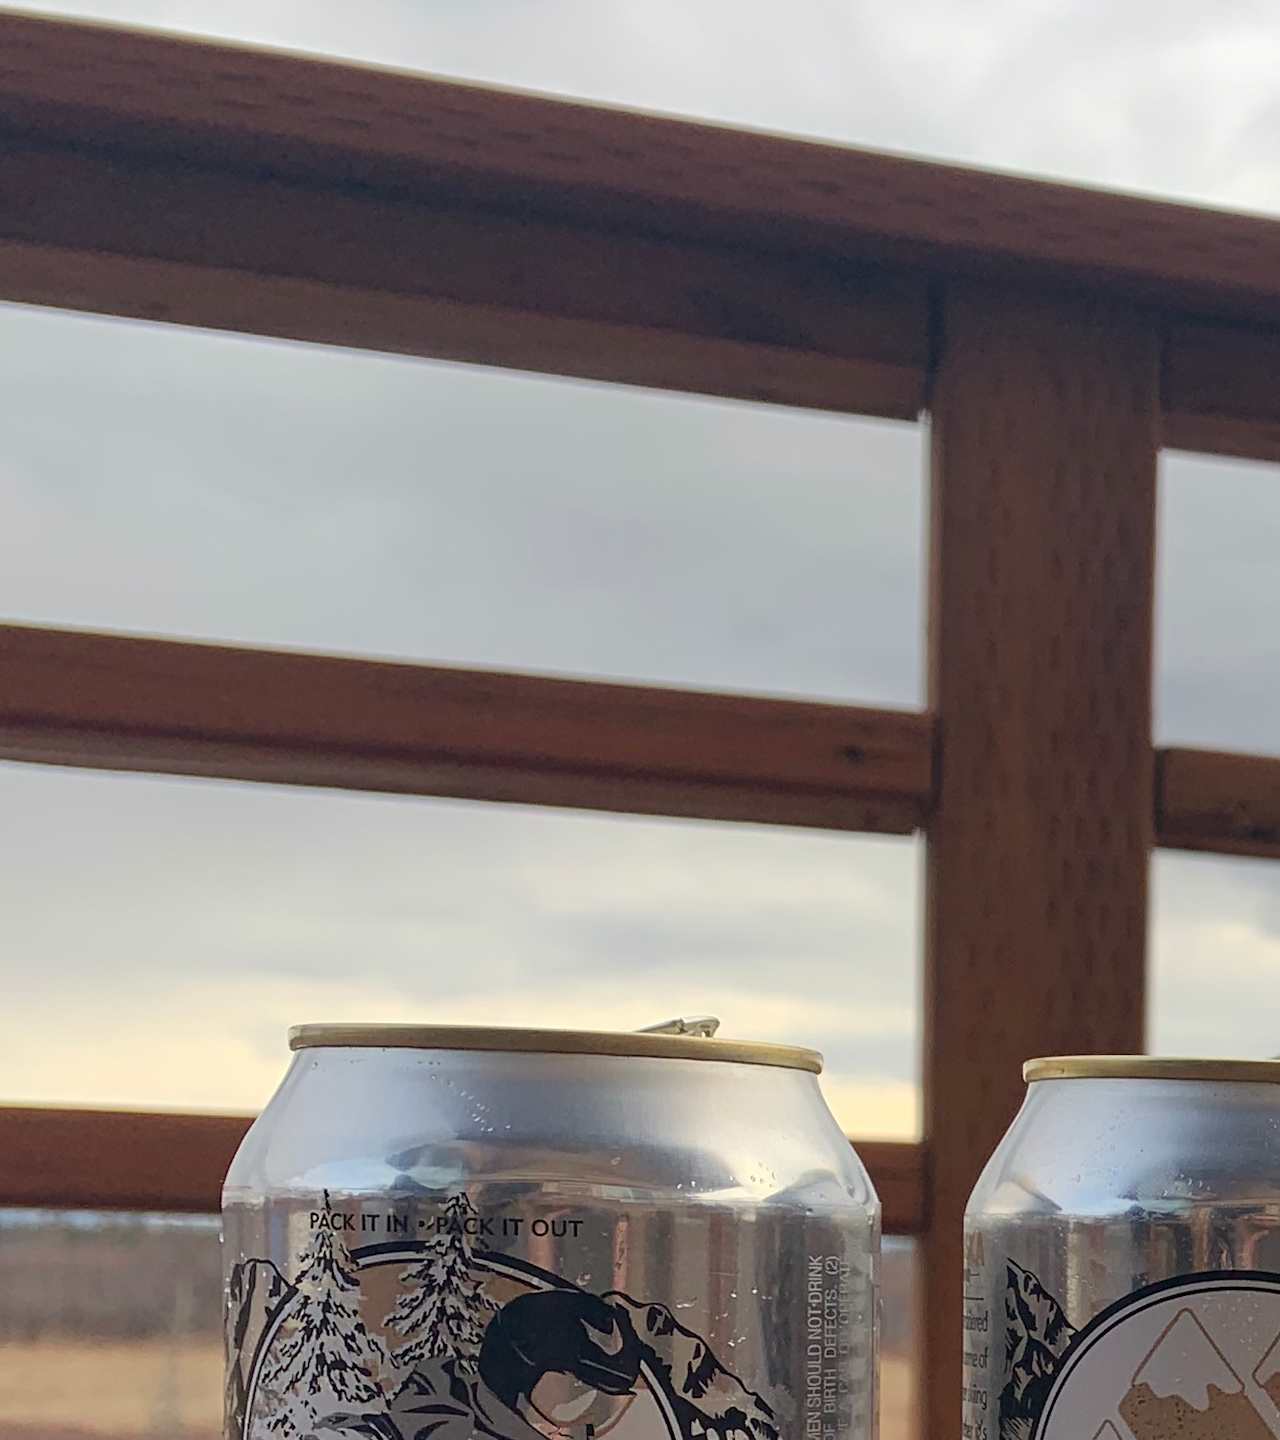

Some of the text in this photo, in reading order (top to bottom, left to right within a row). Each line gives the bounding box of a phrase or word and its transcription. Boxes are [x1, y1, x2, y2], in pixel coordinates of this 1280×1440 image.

[310, 1212, 585, 1238] PACK IT IN PACK IT OUT
[807, 1256, 824, 1303] DRINK
[824, 1256, 840, 1275] (2)
[807, 1306, 822, 1340] NOT
[824, 1286, 839, 1358] DEFECTS.
[807, 1344, 822, 1408] SHOULD
[823, 1369, 838, 1411] BIRTH
